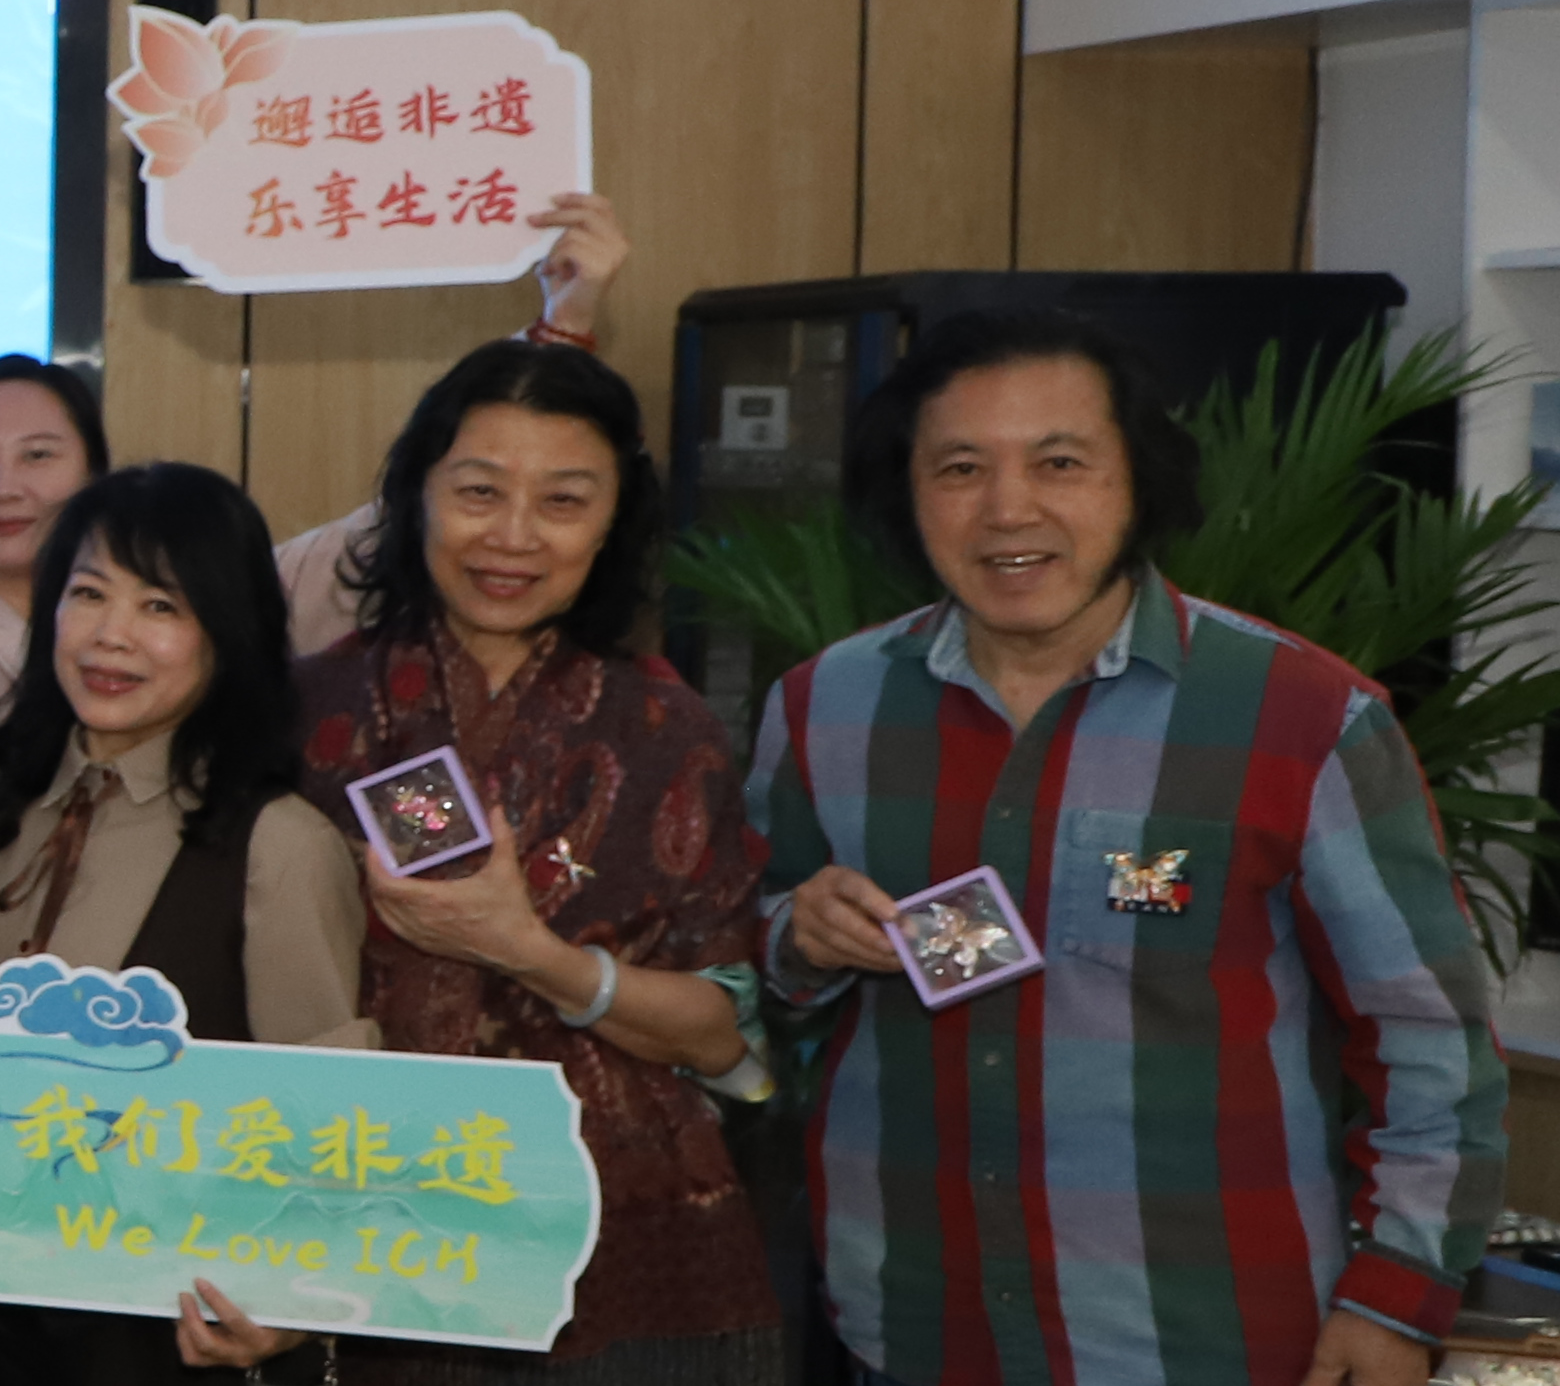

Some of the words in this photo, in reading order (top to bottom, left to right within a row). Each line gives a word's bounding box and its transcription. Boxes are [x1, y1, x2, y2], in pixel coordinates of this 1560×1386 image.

[244, 168, 519, 240] 乐享生活
[13, 1083, 520, 1207] 我们爱非遗
[55, 1204, 153, 1258] We
[177, 1214, 330, 1271] Love
[353, 1226, 480, 1284] ICH
